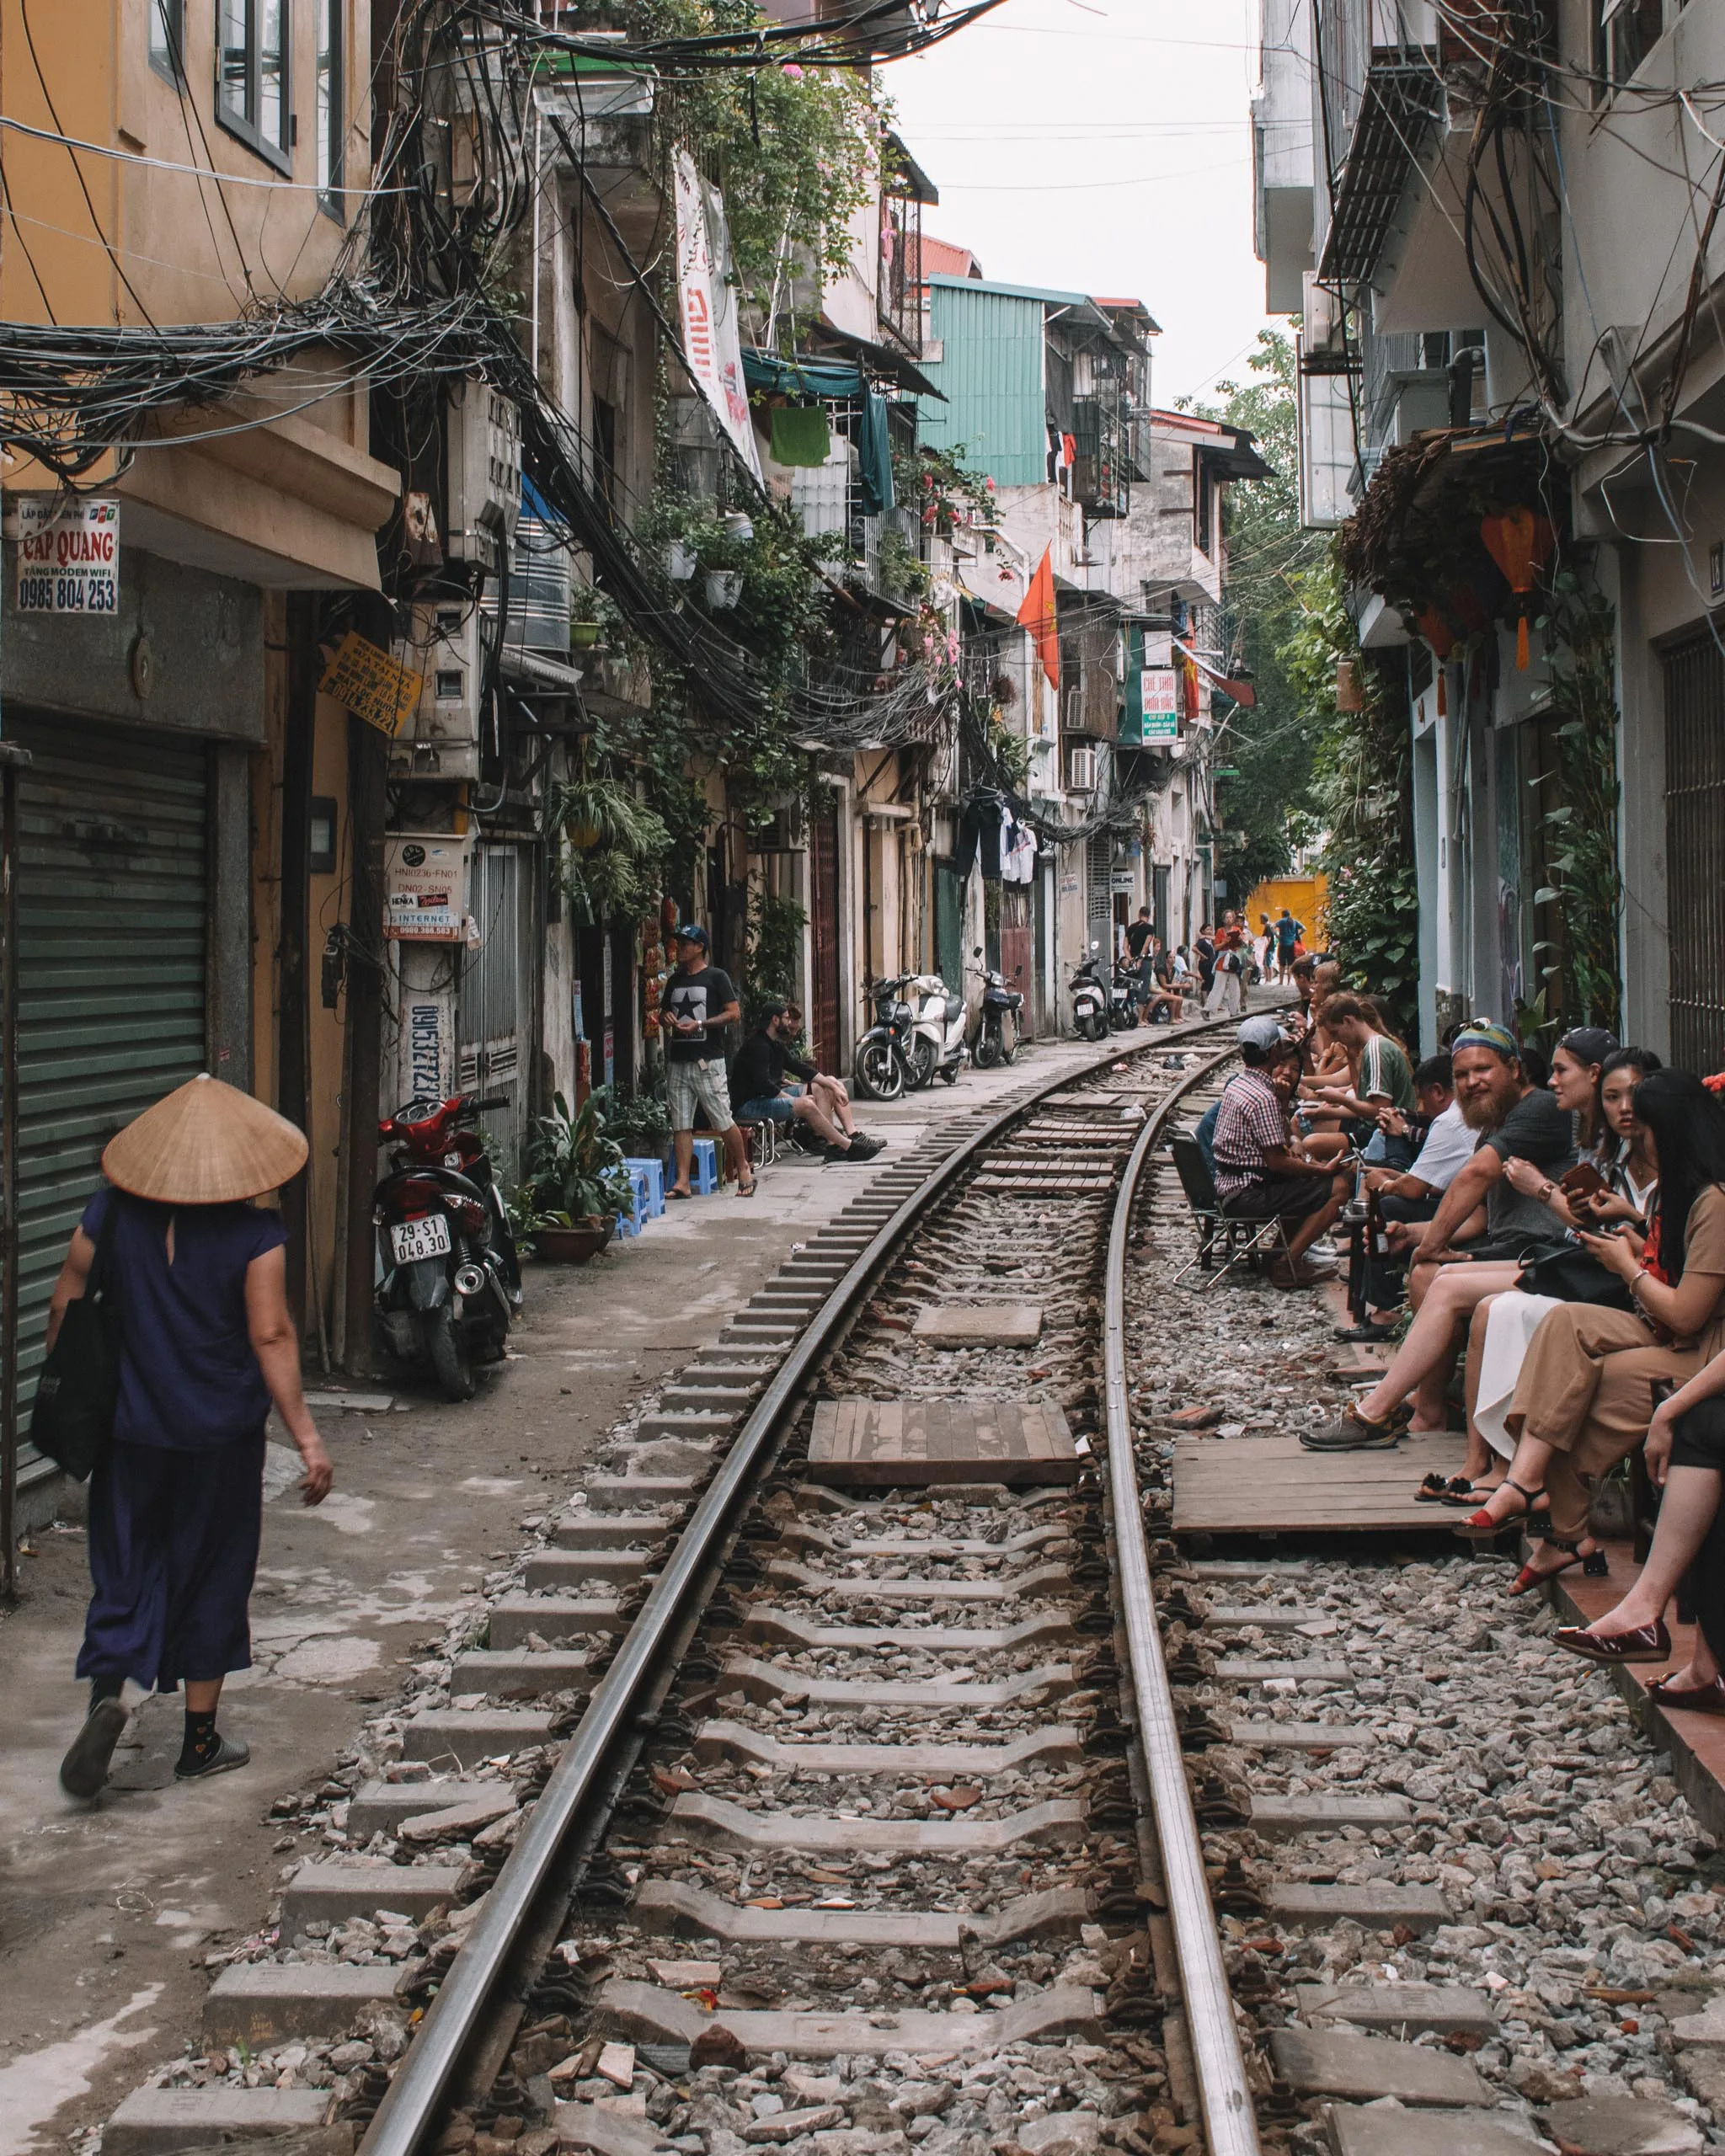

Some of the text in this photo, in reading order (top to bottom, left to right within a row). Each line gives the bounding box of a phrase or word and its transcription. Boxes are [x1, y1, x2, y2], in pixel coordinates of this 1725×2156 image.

[89, 506, 115, 522] FPT
[57, 531, 114, 567] QUANG
[51, 568, 88, 577] MODEM
[89, 568, 110, 577] WIFI
[19, 578, 115, 611] 0985 804 253
[399, 915, 451, 923] INTERNET
[400, 1219, 438, 1242] 29-S1
[398, 1235, 446, 1261] 048.30
